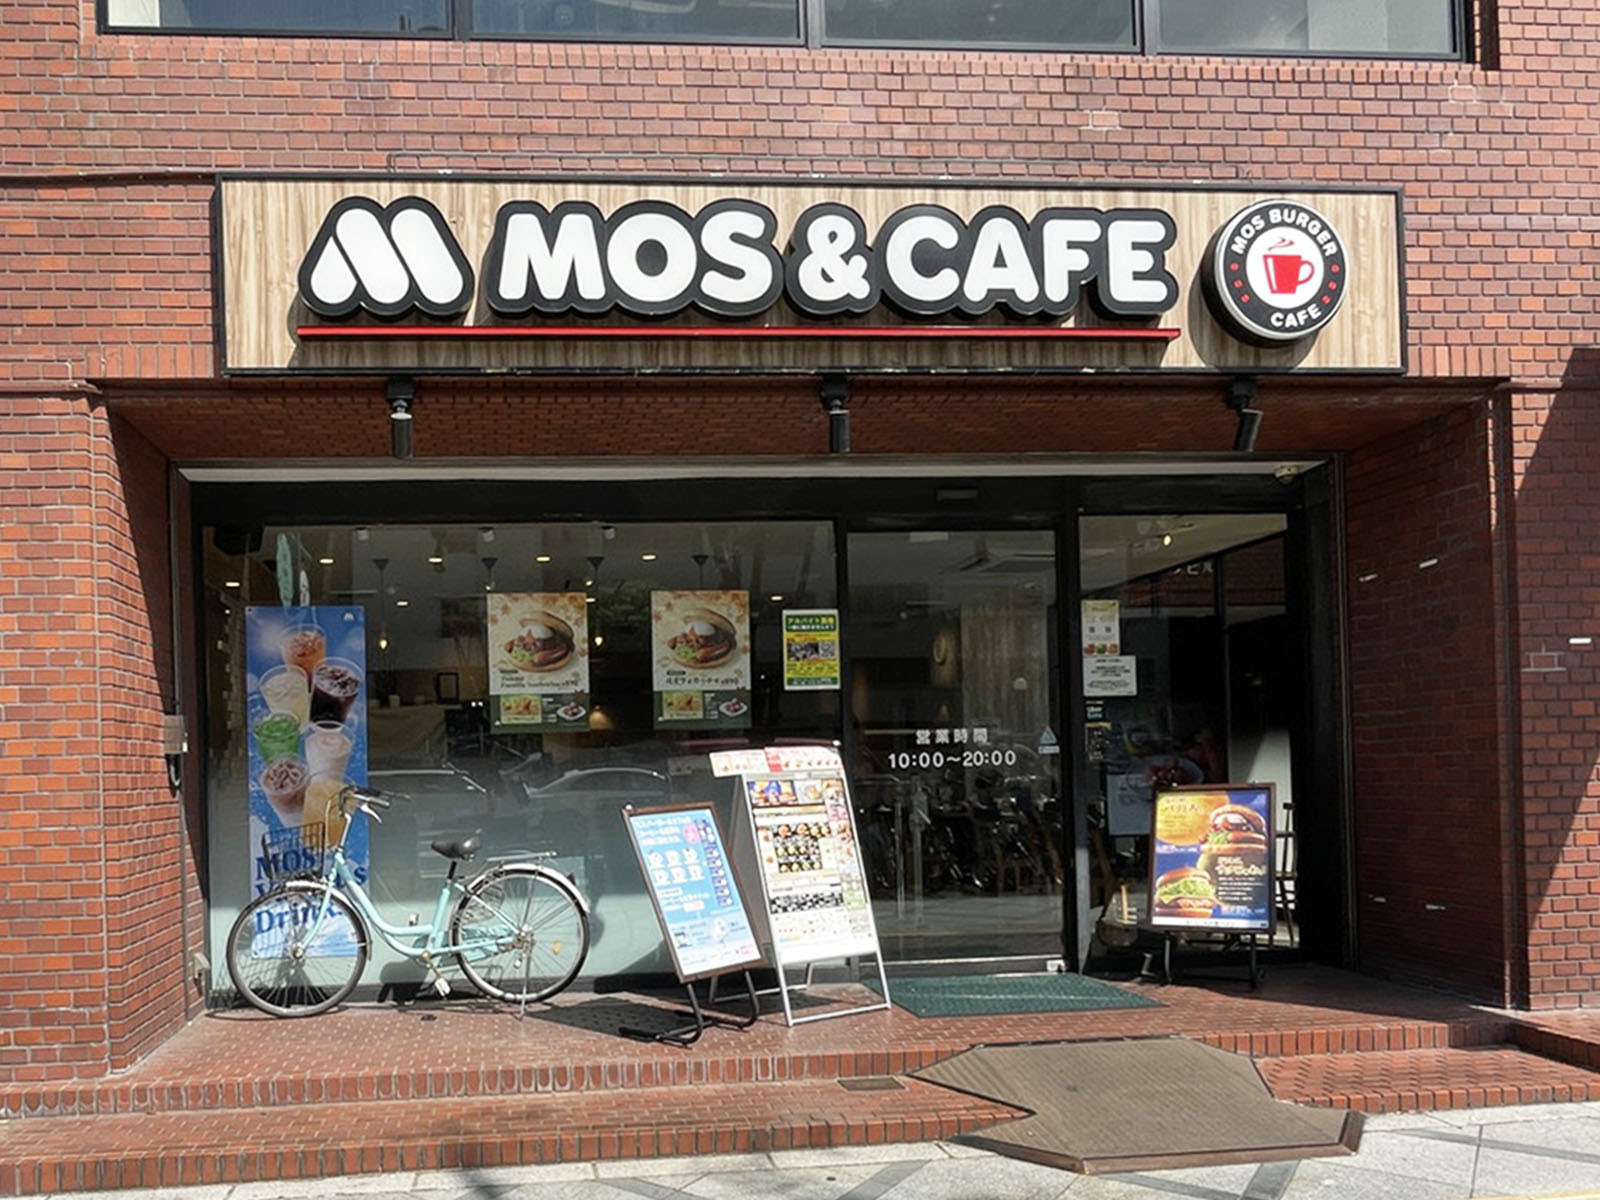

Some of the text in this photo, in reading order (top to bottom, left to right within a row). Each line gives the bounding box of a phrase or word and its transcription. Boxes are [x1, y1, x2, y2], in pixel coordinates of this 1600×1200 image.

[1230, 208, 1338, 257] MOS BURGER
[495, 207, 1170, 306] MOS & CAFE
[1270, 303, 1322, 328] CAFE
[915, 727, 989, 745] 営業時間
[256, 848, 317, 880] MOS
